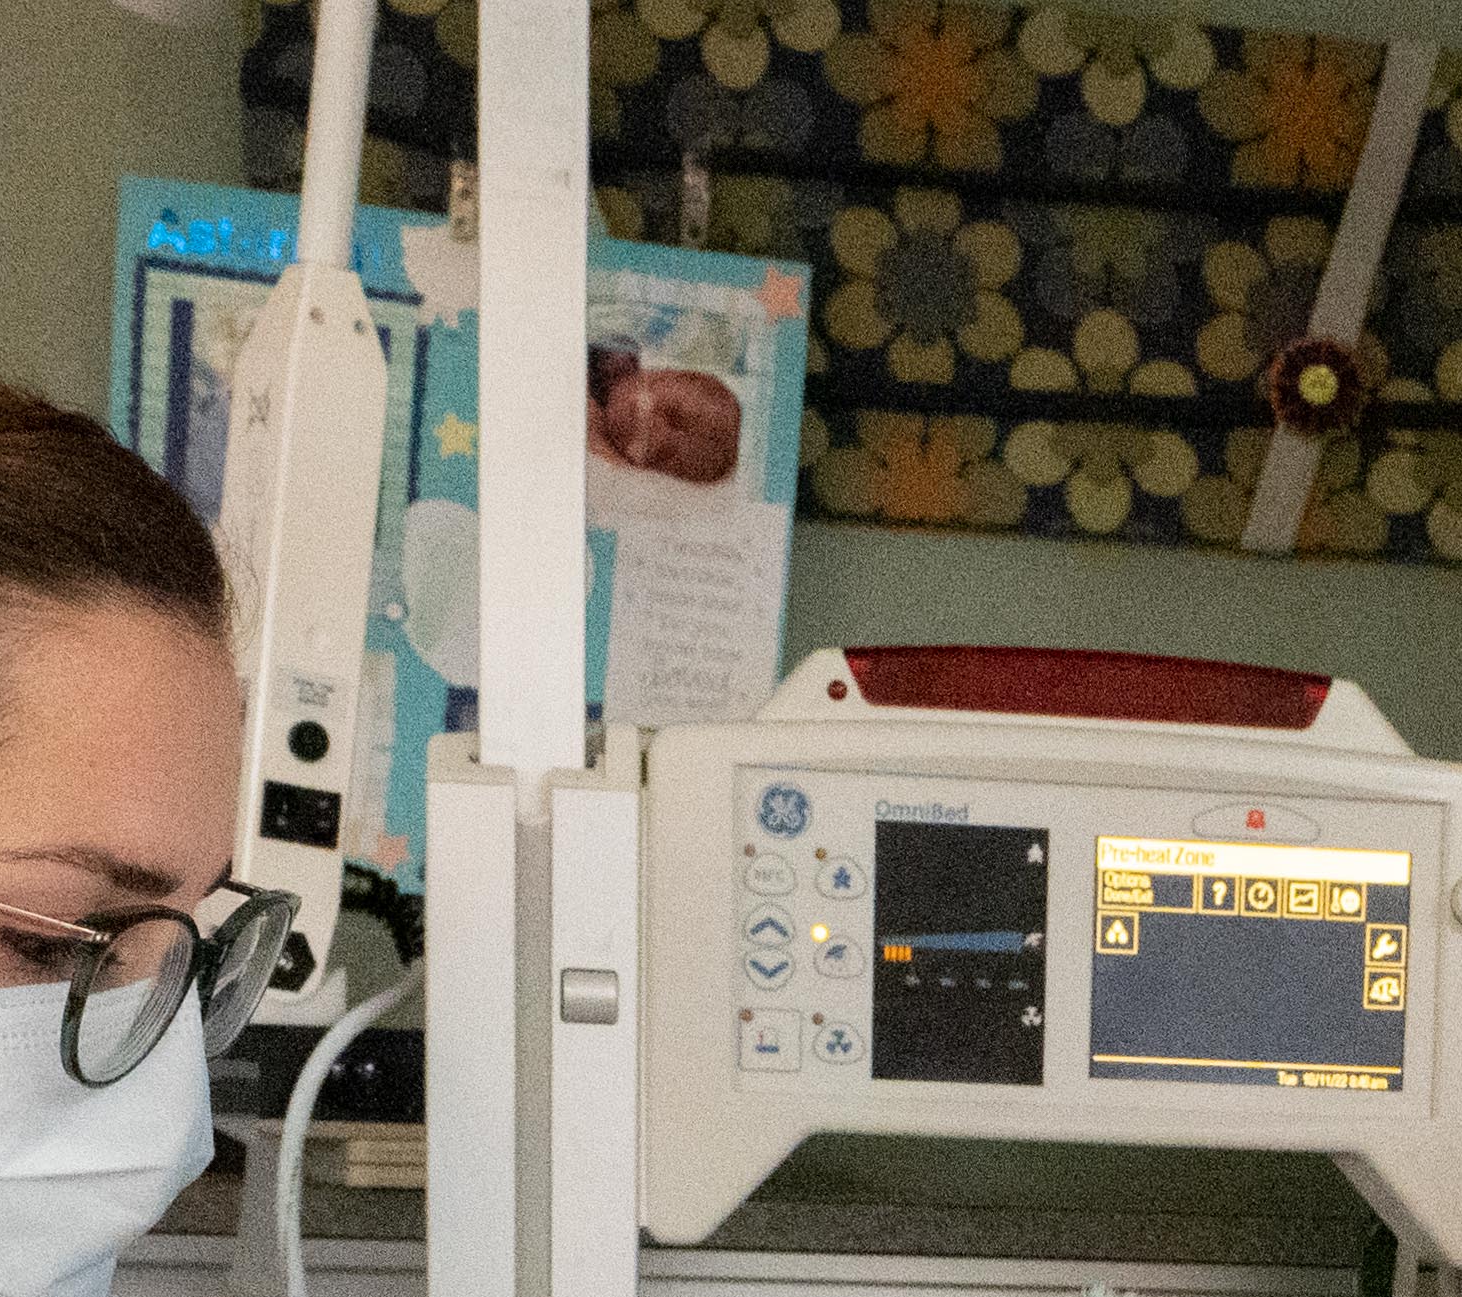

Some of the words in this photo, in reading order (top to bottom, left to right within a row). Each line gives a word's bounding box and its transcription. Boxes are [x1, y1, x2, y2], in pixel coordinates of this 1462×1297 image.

[874, 800, 969, 823] OmniBed
[1100, 842, 1171, 865] Pre-heat
[1173, 846, 1216, 867] Zone
